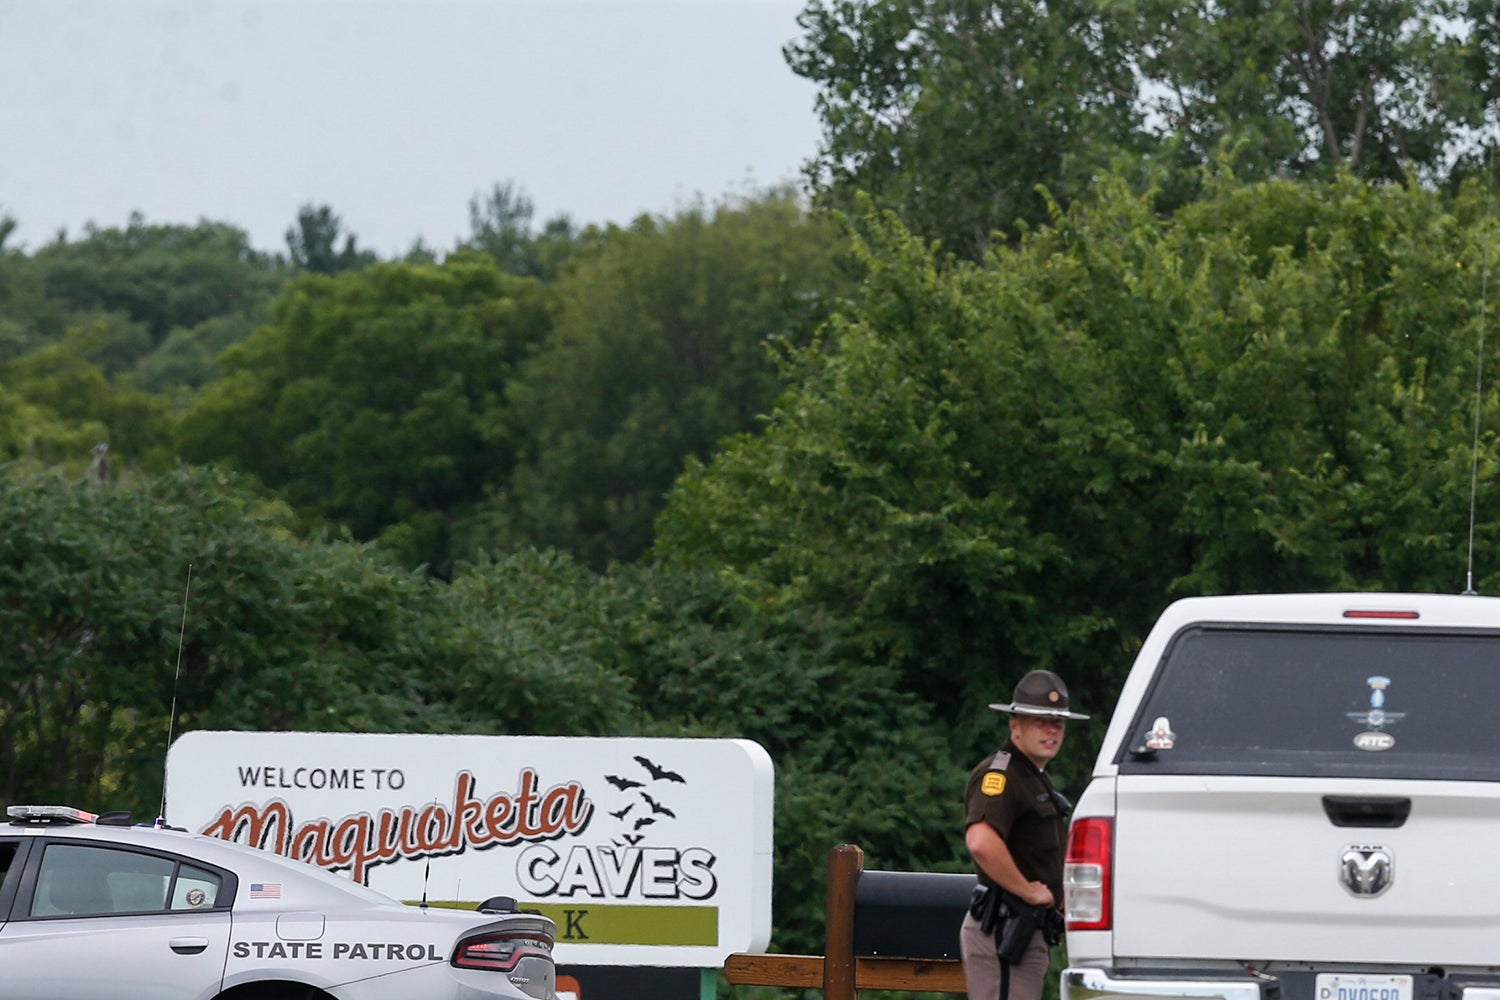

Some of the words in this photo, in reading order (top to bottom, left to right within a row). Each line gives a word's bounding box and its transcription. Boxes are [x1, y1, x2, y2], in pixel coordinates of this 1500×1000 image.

[238, 766, 365, 790] WELCOME
[372, 769, 405, 790] TO
[201, 767, 594, 888] Maquoketa
[515, 844, 718, 901] CAVES
[233, 941, 323, 959] STATE
[333, 943, 444, 961] PATROL
